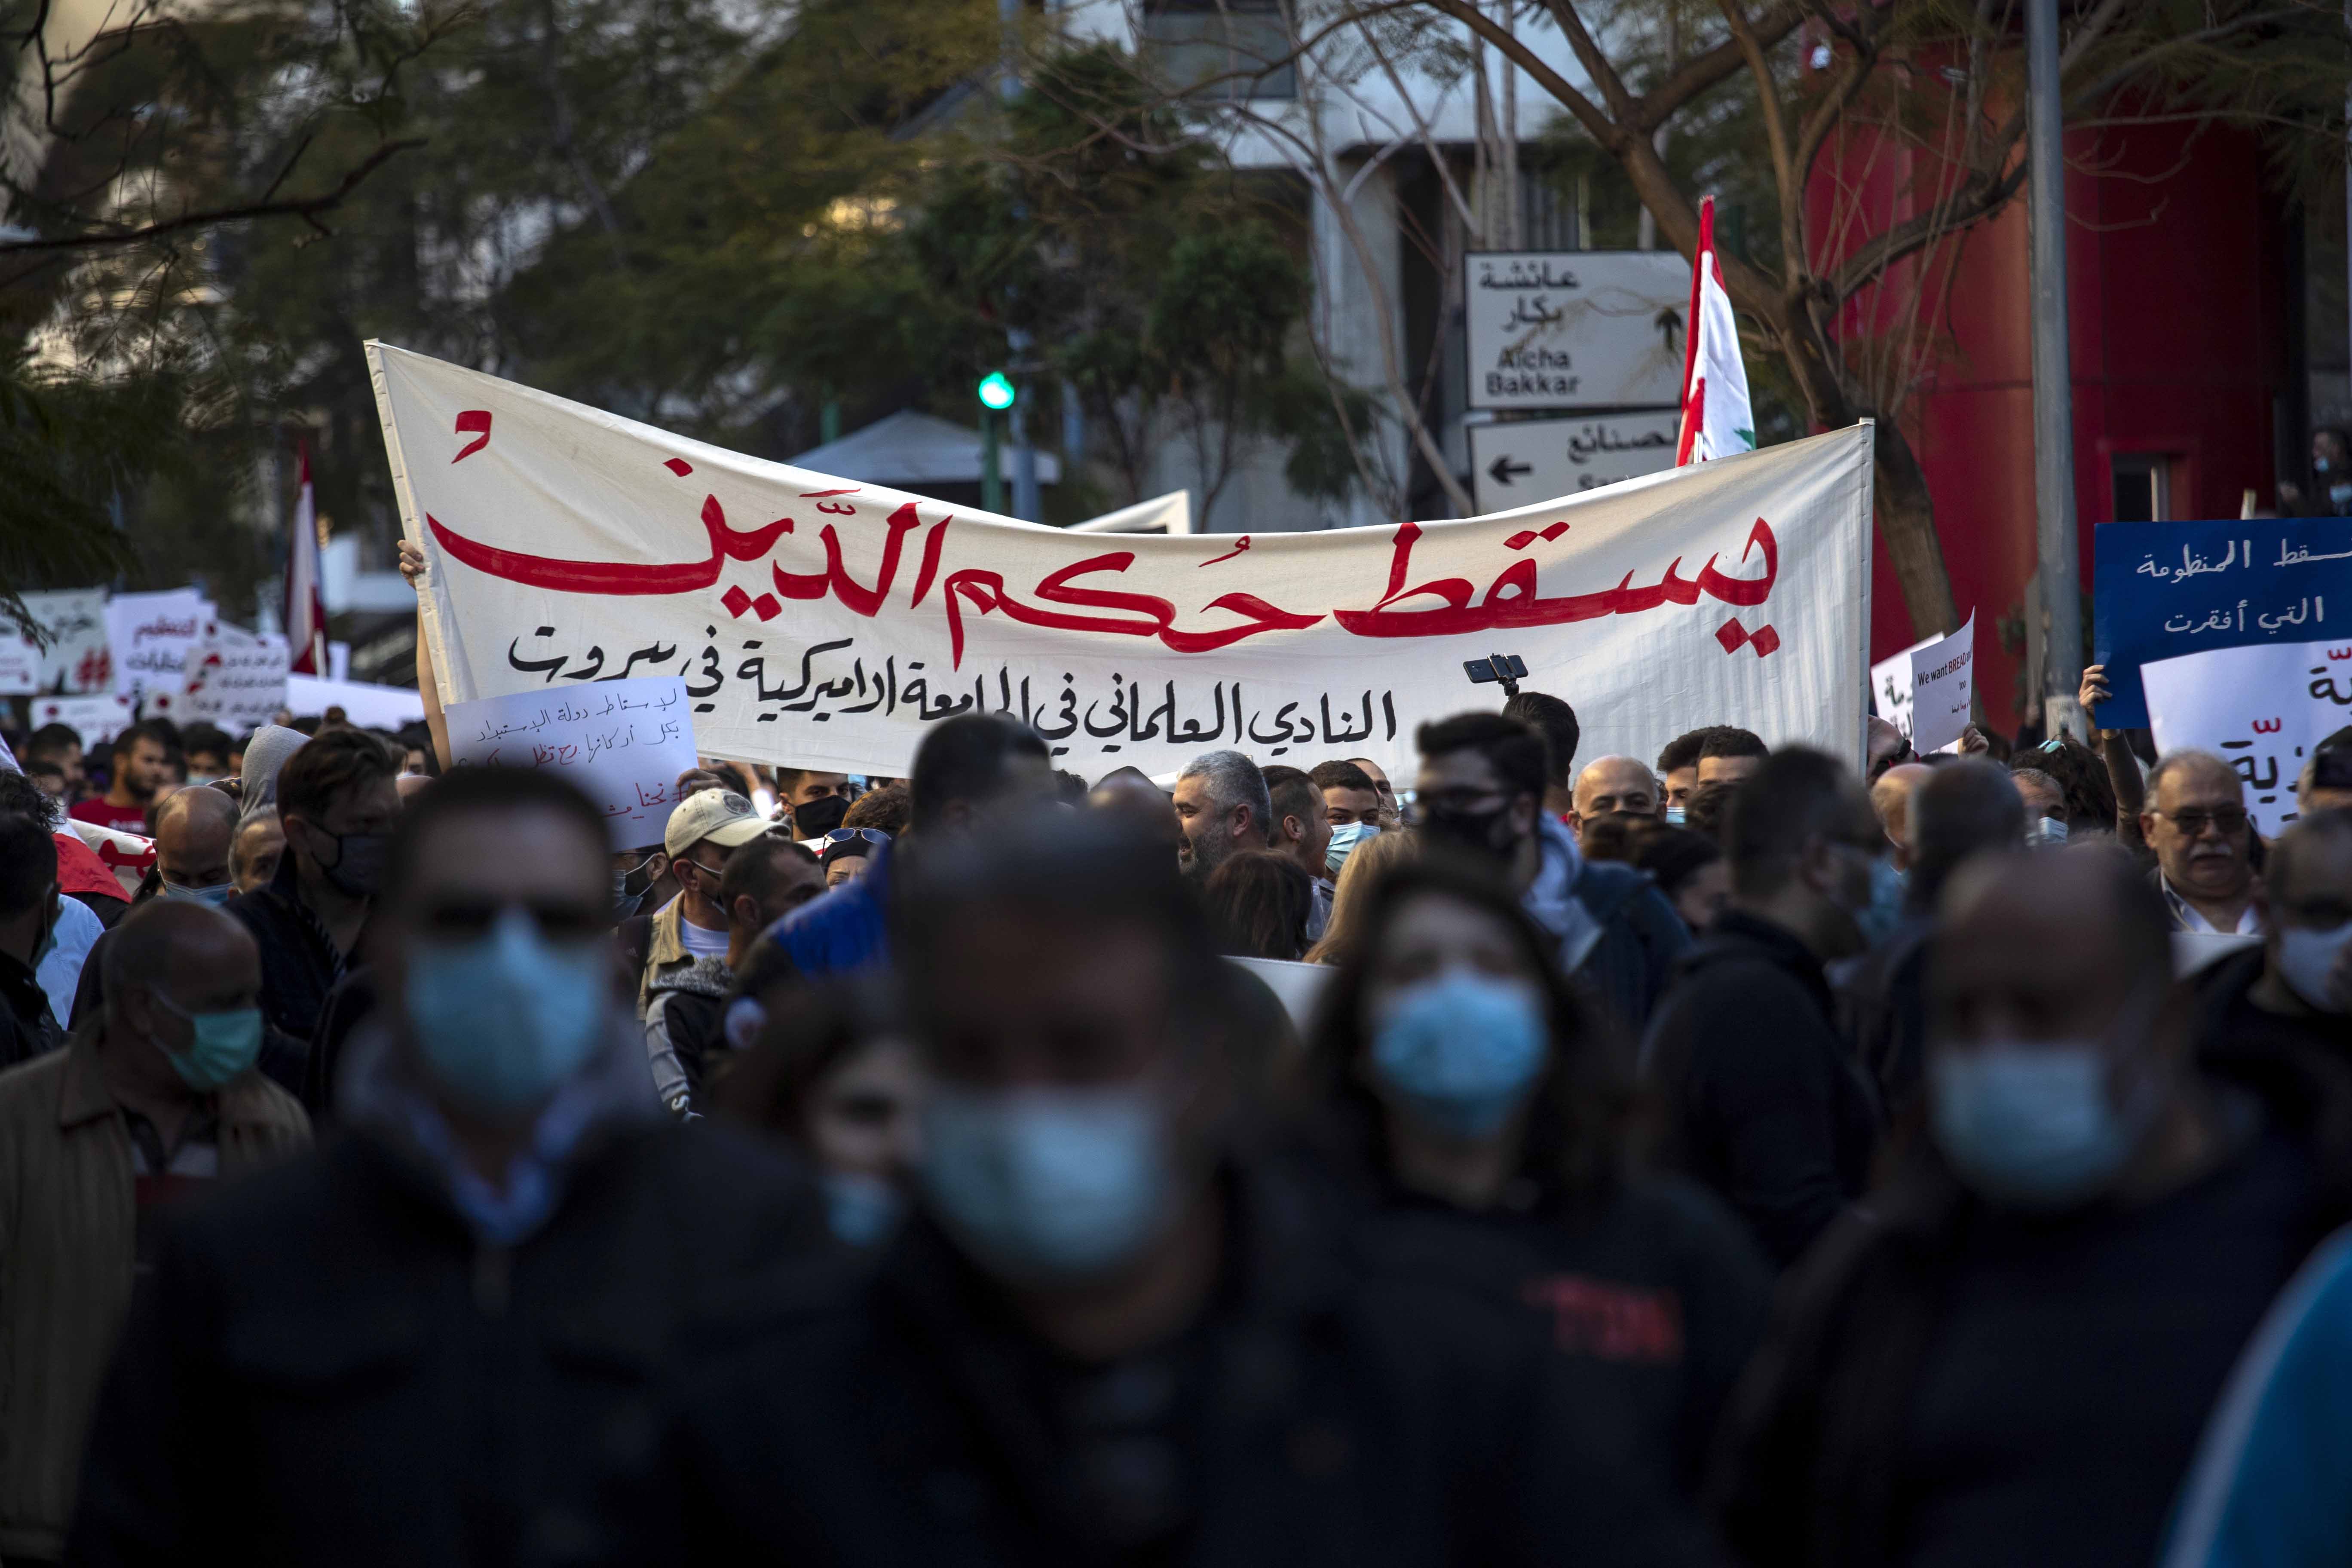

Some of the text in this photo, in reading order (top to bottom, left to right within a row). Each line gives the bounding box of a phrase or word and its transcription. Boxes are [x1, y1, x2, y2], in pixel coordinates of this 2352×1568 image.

[1498, 347, 1570, 370] Aicha
[1486, 373, 1580, 396] Bakkar
[2137, 539, 2251, 583] المنظومة
[1332, 516, 1781, 658] يسقط
[2258, 596, 2324, 634] التي
[679, 625, 724, 713] في
[1917, 671, 1929, 687] We
[1931, 662, 1948, 681] want
[1948, 652, 1966, 674] BREAD
[557, 701, 588, 722] دولة
[1033, 672, 1078, 756] في
[1084, 673, 1243, 753] العلماني
[1248, 689, 1396, 756] النادي
[642, 720, 679, 745] بكل
